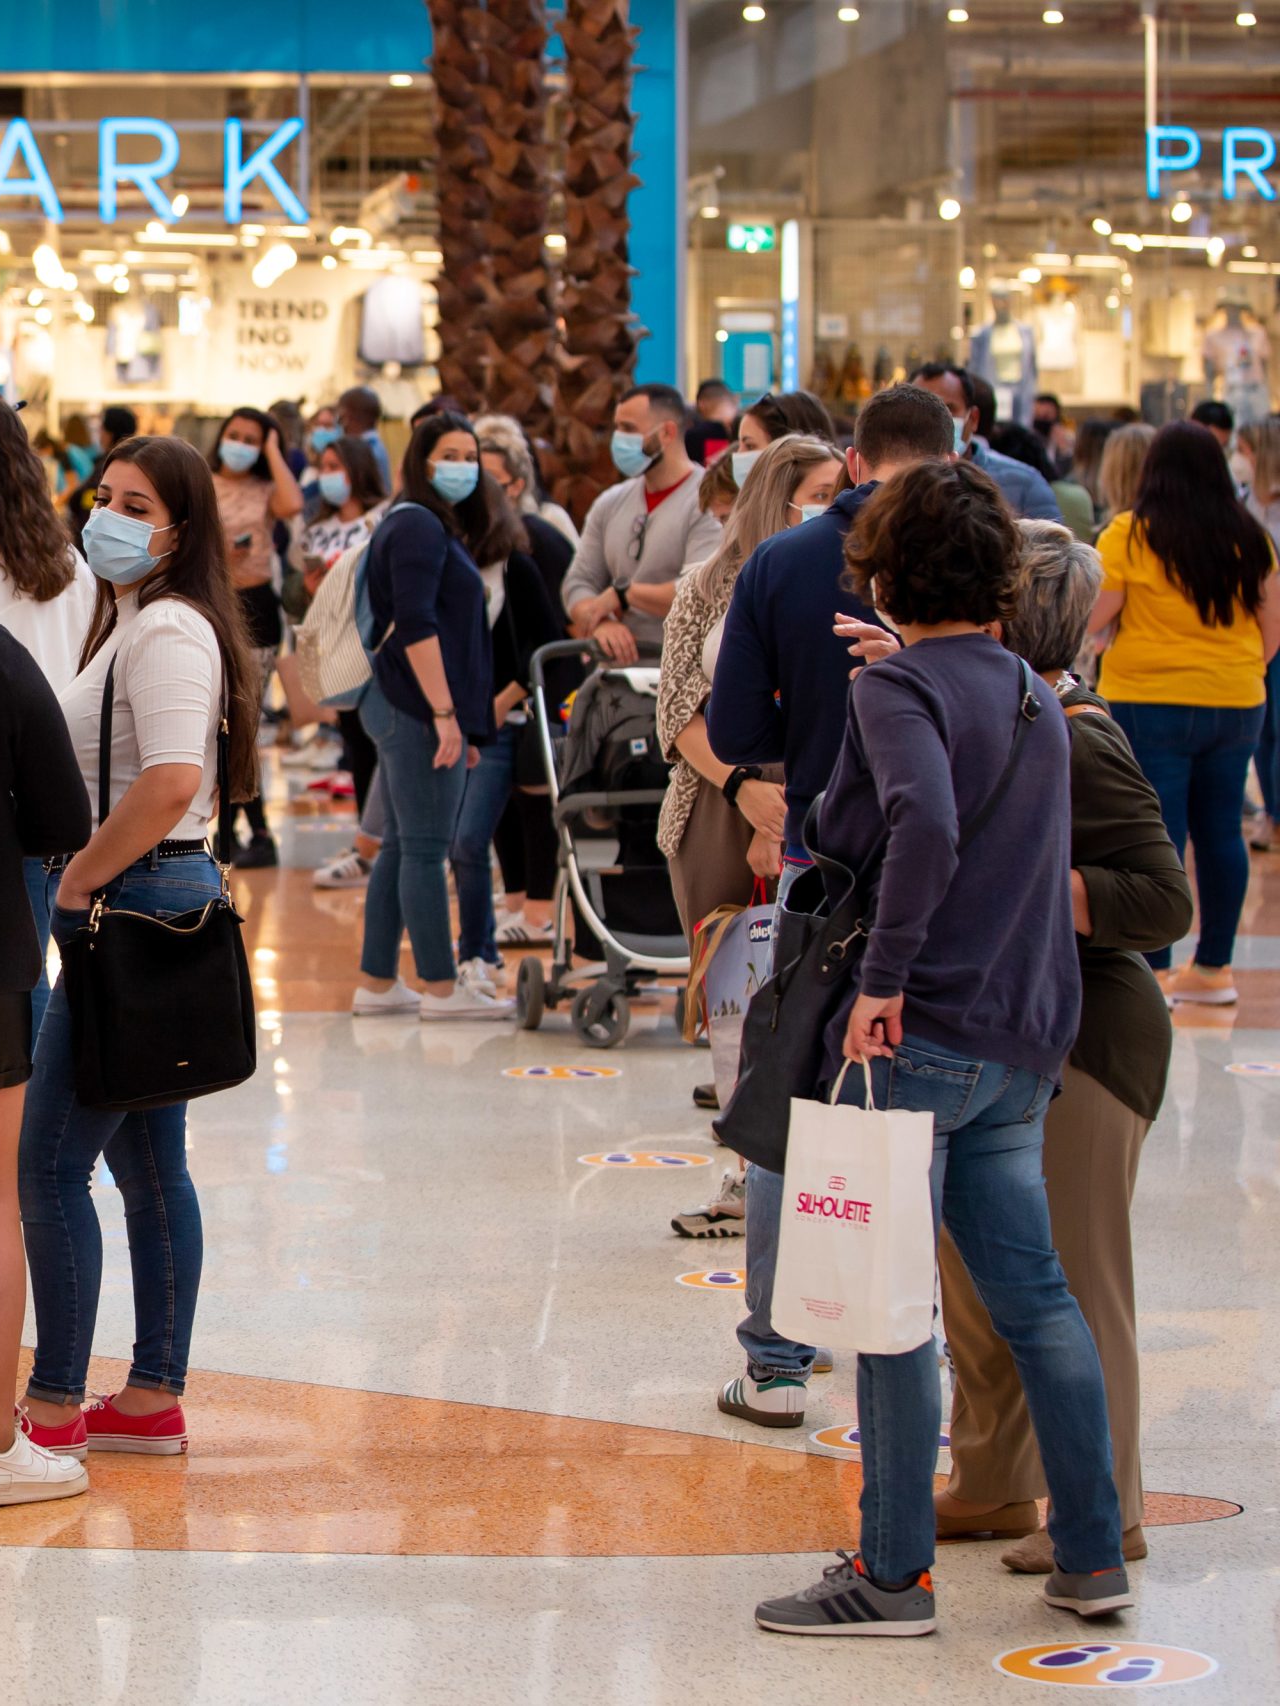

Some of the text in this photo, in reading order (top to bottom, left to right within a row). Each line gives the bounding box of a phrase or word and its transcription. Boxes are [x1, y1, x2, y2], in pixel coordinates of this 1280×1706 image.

[1146, 125, 1277, 200] PR
[238, 299, 328, 320] TREND
[238, 326, 291, 345] ING
[238, 353, 310, 371] NOW
[796, 1192, 872, 1223] SILHOUETTE
